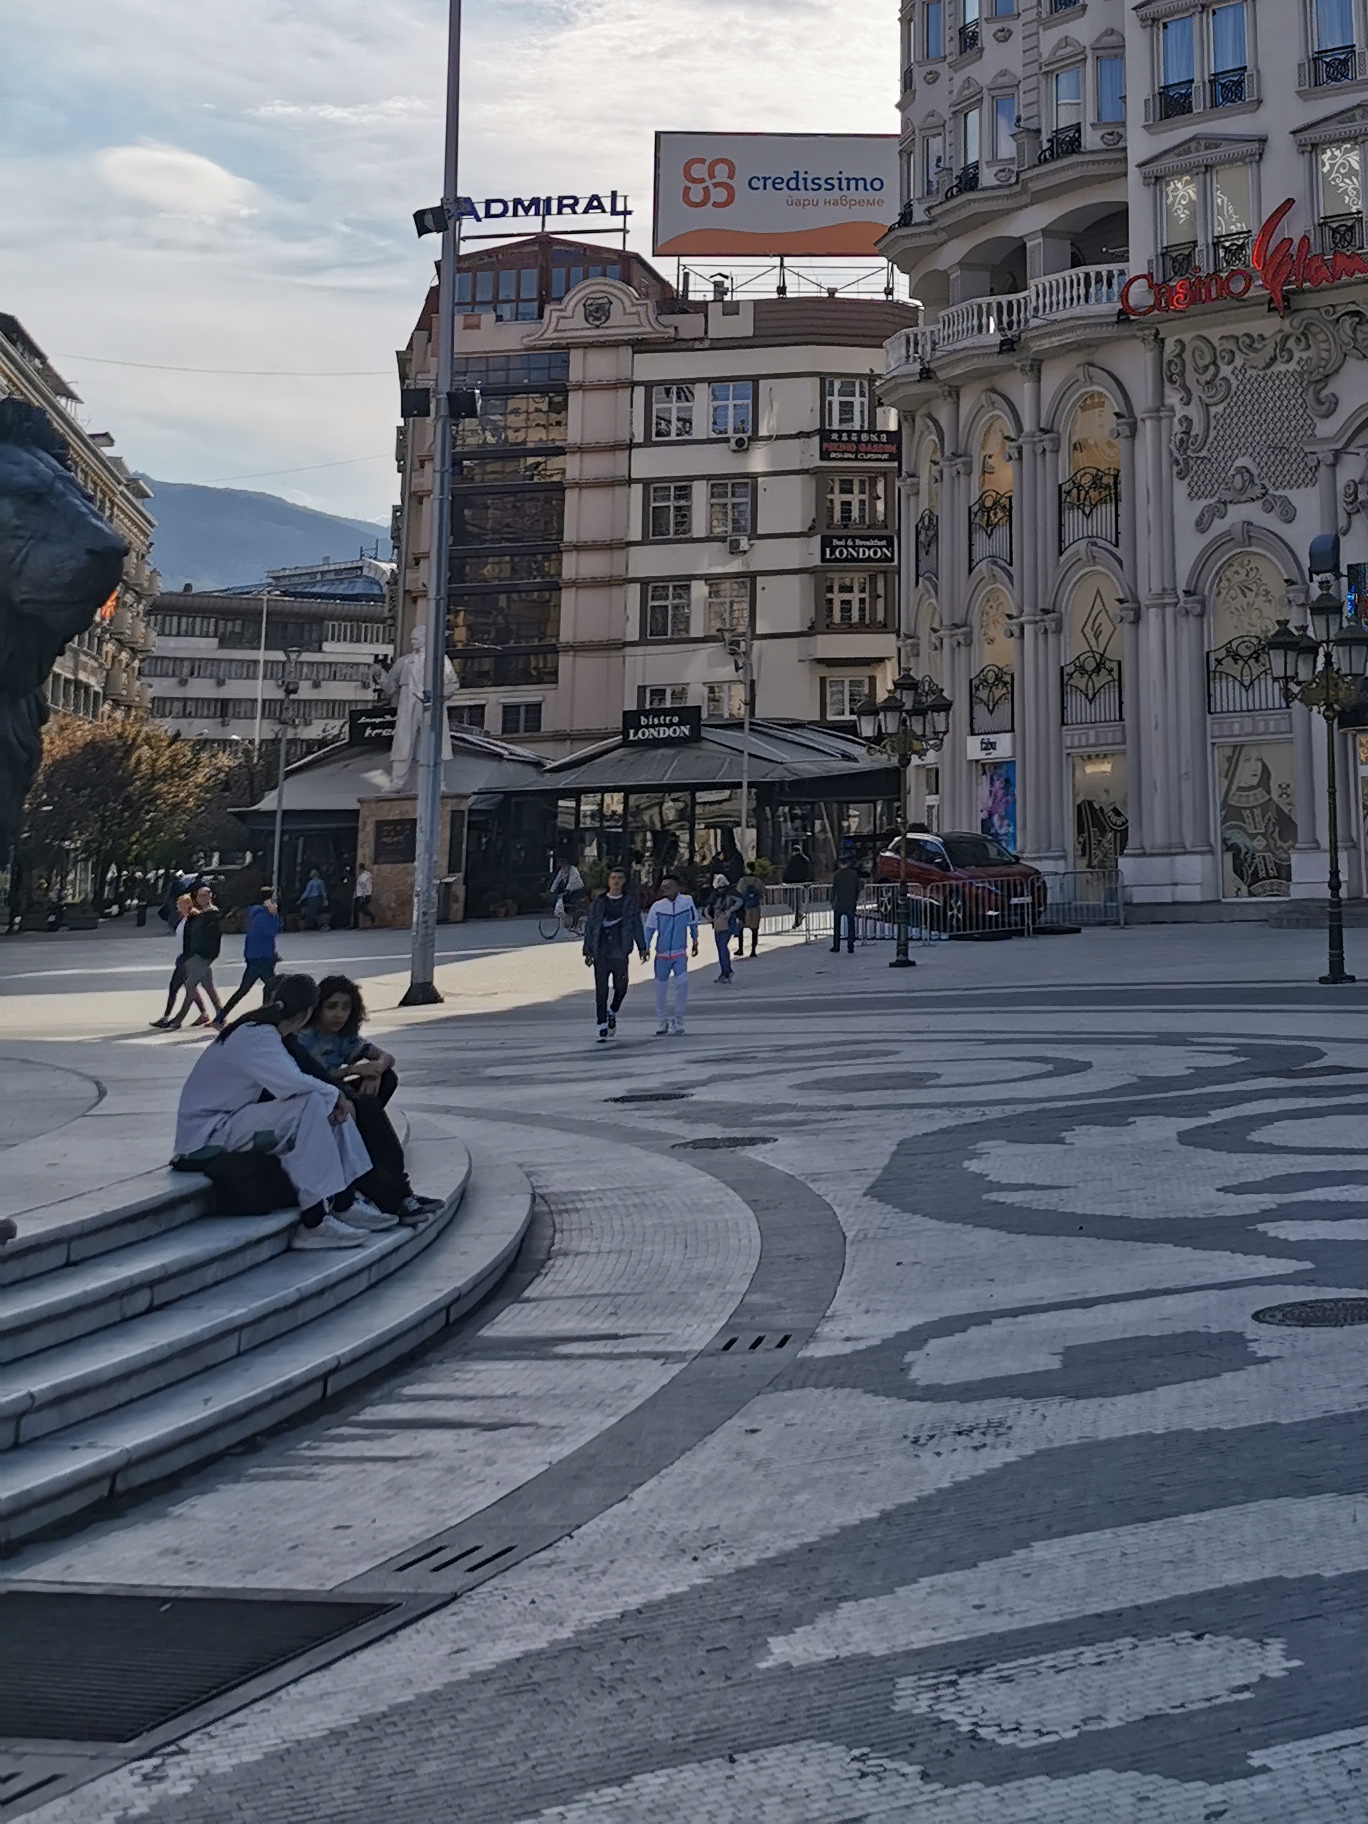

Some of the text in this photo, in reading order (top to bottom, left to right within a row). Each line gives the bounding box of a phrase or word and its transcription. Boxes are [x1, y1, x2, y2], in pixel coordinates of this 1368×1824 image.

[748, 170, 885, 192] credissimo
[456, 190, 634, 223] ADMIRAL
[1121, 263, 1251, 316] Casino
[825, 547, 893, 560] LONDON
[640, 714, 680, 726] bistro
[628, 724, 691, 741] LONDON
